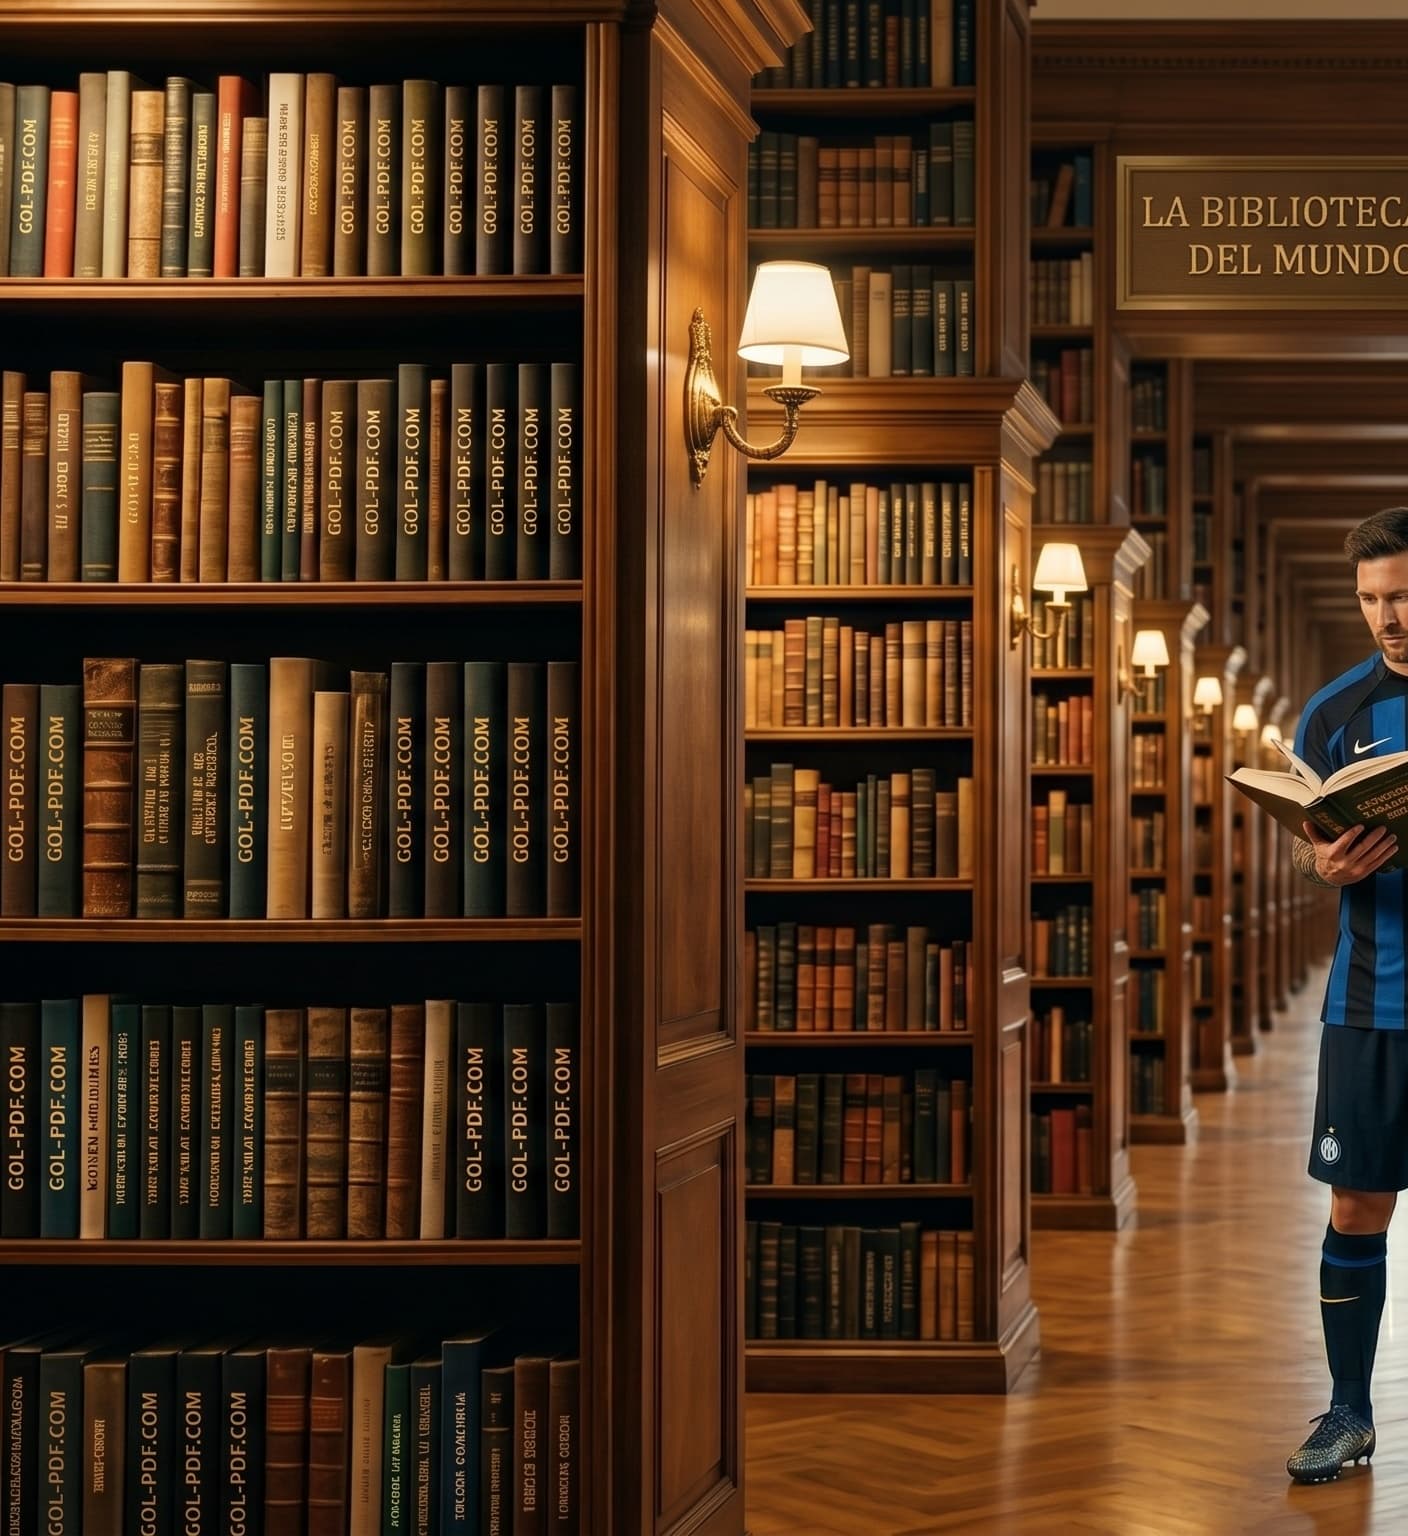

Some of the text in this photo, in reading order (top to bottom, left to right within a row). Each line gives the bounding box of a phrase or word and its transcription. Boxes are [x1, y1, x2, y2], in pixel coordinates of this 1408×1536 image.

[18, 118, 38, 235] GOL-PDF.COM
[340, 118, 356, 235] GOL-PDF.COM
[375, 118, 391, 235] GOL-PDF.COM
[410, 118, 425, 235] GOL-PDF.COM
[448, 118, 464, 235] GOL-PDF.COM
[483, 118, 498, 235] GOL-PDF.COM
[519, 118, 535, 235] GOL-PDF.COM
[556, 118, 572, 235] GOL-PDF.COM
[1141, 195, 1190, 229] LA
[1187, 243, 1262, 276] DEL
[327, 410, 344, 536] GOL-PDF.COM
[364, 410, 381, 536] GOL-PDF.COM
[403, 408, 421, 535] GOL-PDF.COM
[456, 408, 472, 536] GOL-PDF.COM
[490, 408, 506, 536] GOL-PDF.COM
[523, 408, 539, 536] GOL-PDF.COM
[557, 407, 573, 535] GOL-PDF.COM
[8, 716, 26, 862] GOL-PDF.COM
[46, 716, 65, 862] GOL-PDF.COM
[237, 716, 255, 863] GOL-PDF.COM
[396, 717, 412, 863] GOL-PDF.COM
[432, 717, 451, 863] GOL-PDF.COM
[473, 717, 490, 863] GOL-PDF.COM
[512, 716, 530, 863] GOL-PDF.COM
[552, 717, 570, 863] GOL-PDF.COM
[7, 1046, 26, 1191] GOL-PDF.COM
[48, 1046, 67, 1191] GOL-PDF.COM
[465, 1047, 484, 1192] GOL-PDF.COM
[511, 1048, 528, 1193] GOL-PDF.COM
[554, 1048, 571, 1193] GOL-PDF.COM
[47, 1391, 66, 1536] GOL-PDF.COM
[140, 1392, 158, 1536] GOL-PDF.COM
[184, 1391, 202, 1536] GOL-PDF.COM
[229, 1392, 247, 1536] GOL-PDF.COM
